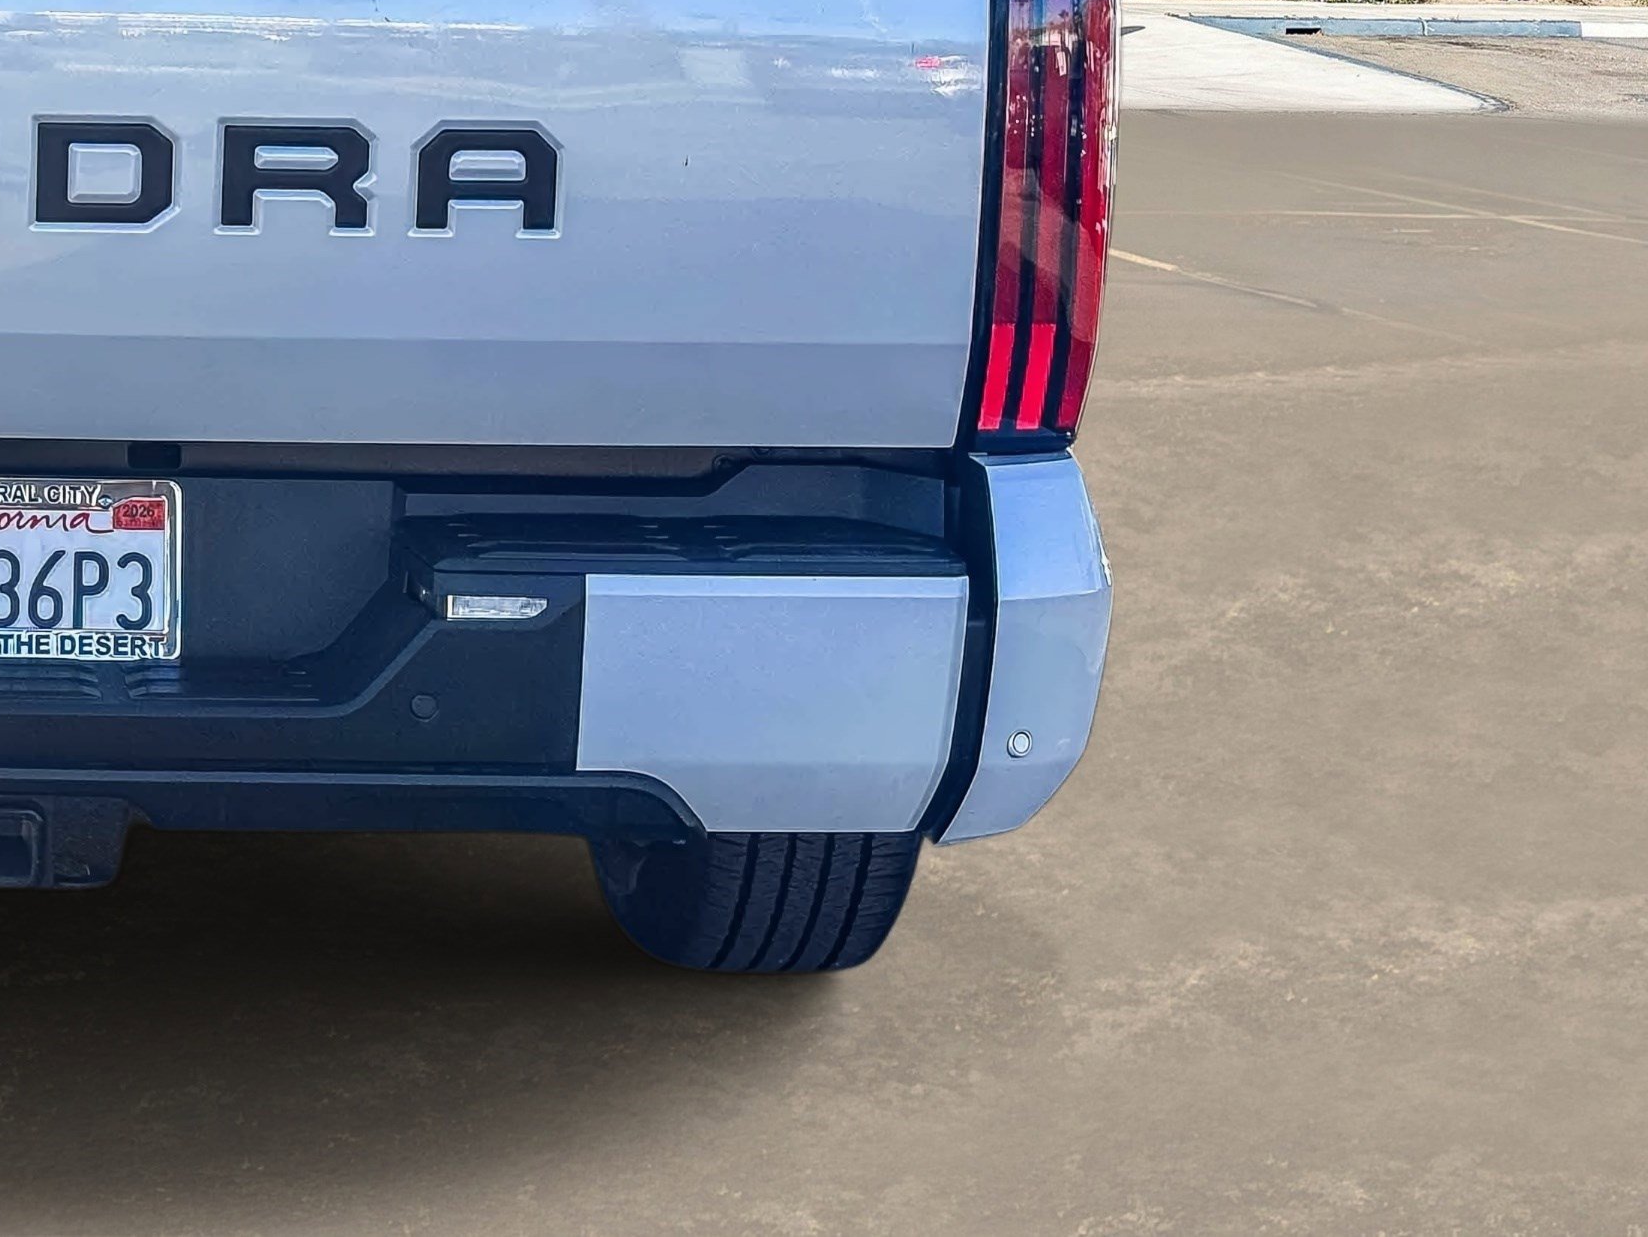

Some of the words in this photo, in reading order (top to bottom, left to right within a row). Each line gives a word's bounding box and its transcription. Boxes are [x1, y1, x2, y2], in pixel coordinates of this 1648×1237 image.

[46, 484, 101, 506] CITY
[122, 504, 155, 518] 2026
[58, 635, 165, 657] DESERT
